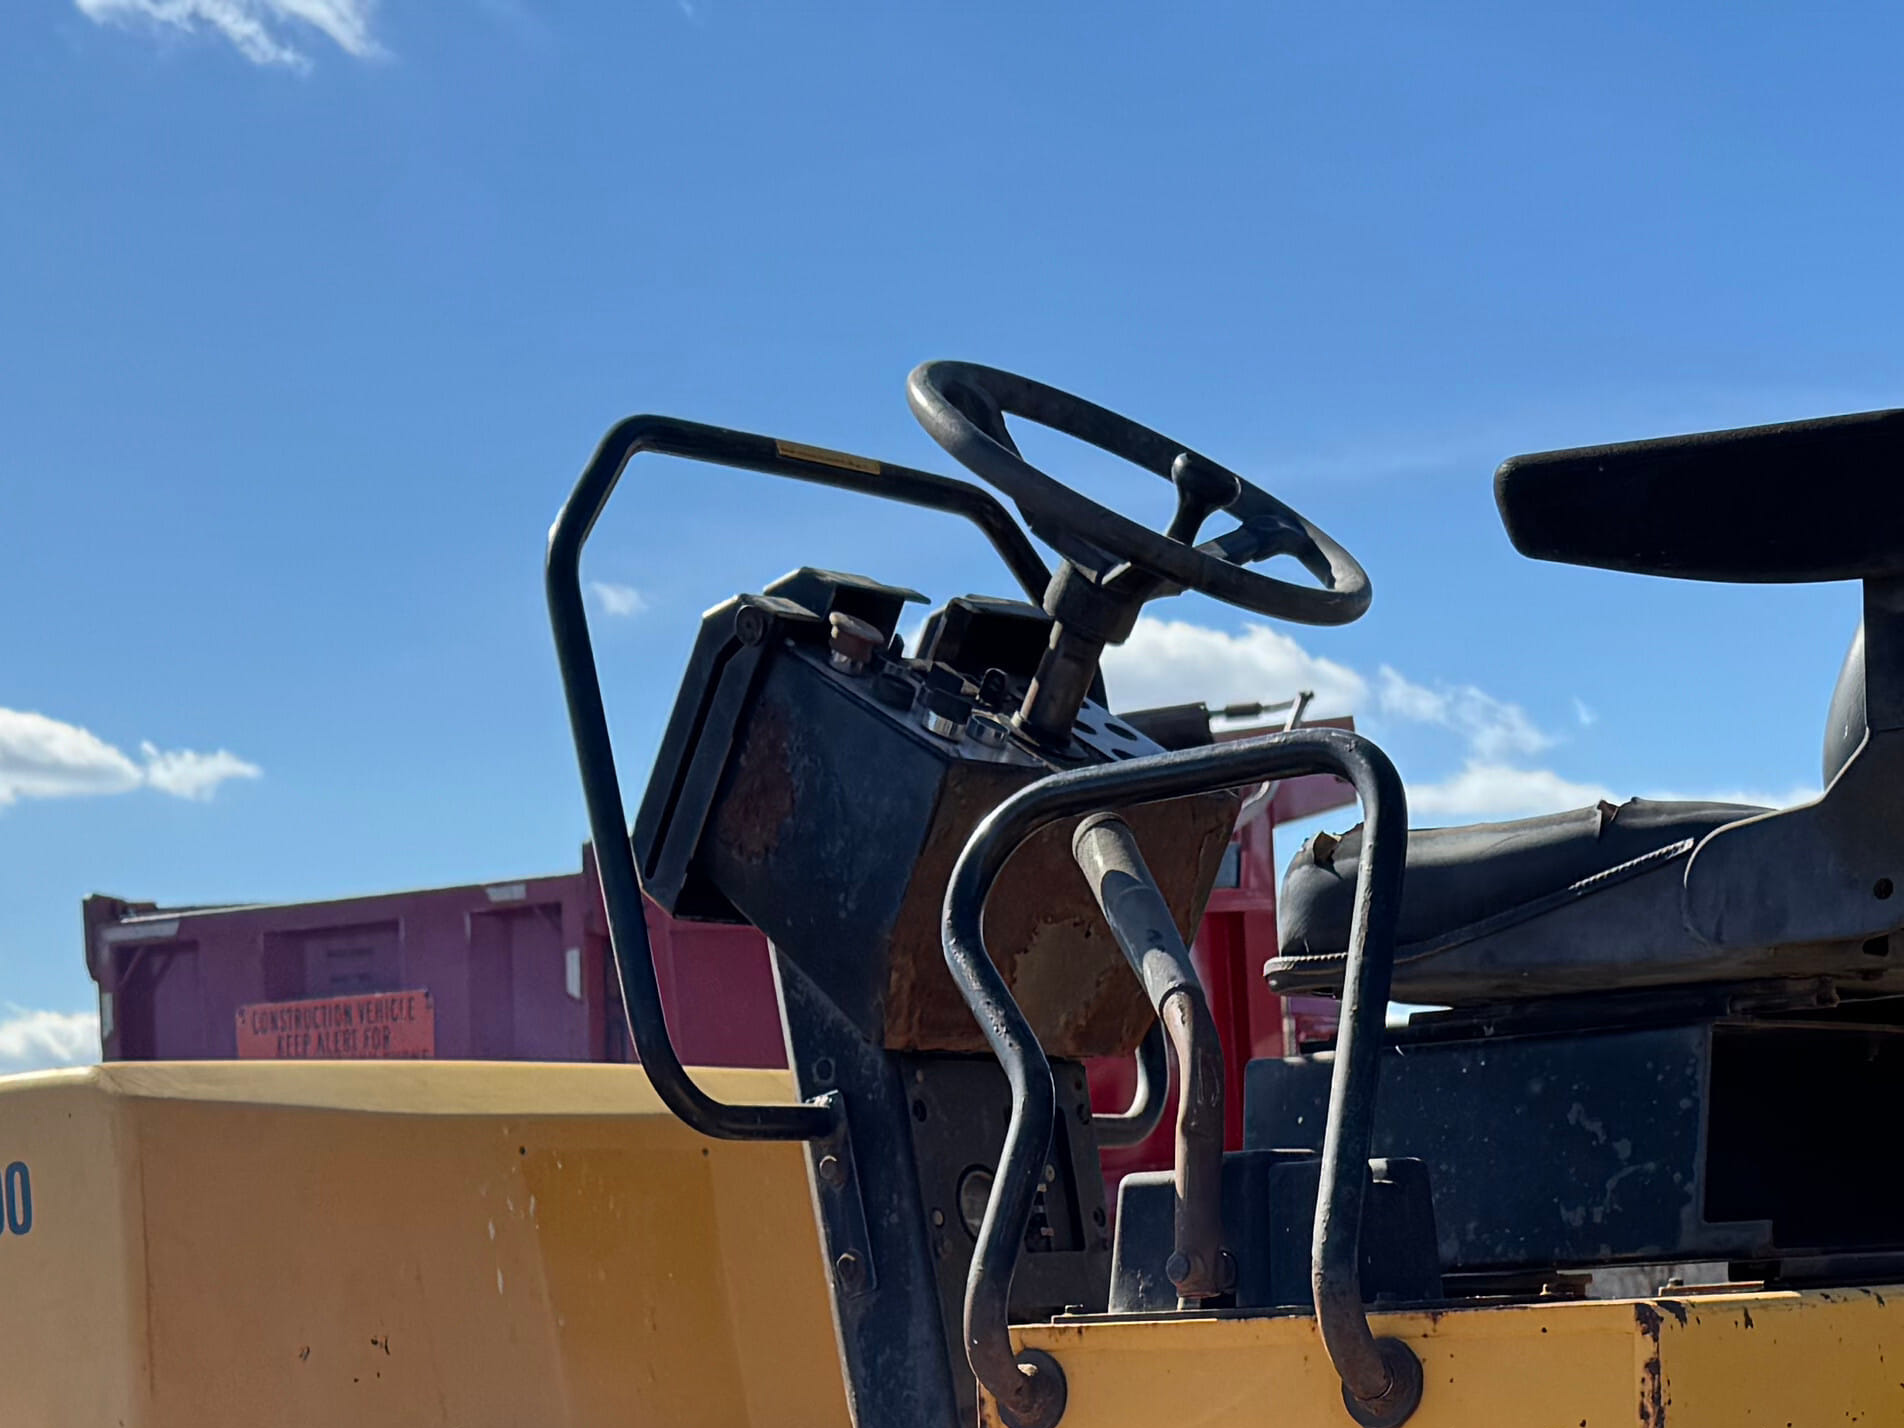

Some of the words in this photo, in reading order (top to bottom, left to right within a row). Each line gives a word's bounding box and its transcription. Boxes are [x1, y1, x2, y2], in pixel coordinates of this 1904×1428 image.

[252, 1004, 353, 1035] CONSTRUCTION
[358, 996, 416, 1024] VEHICLE
[363, 1026, 391, 1050] FOR
